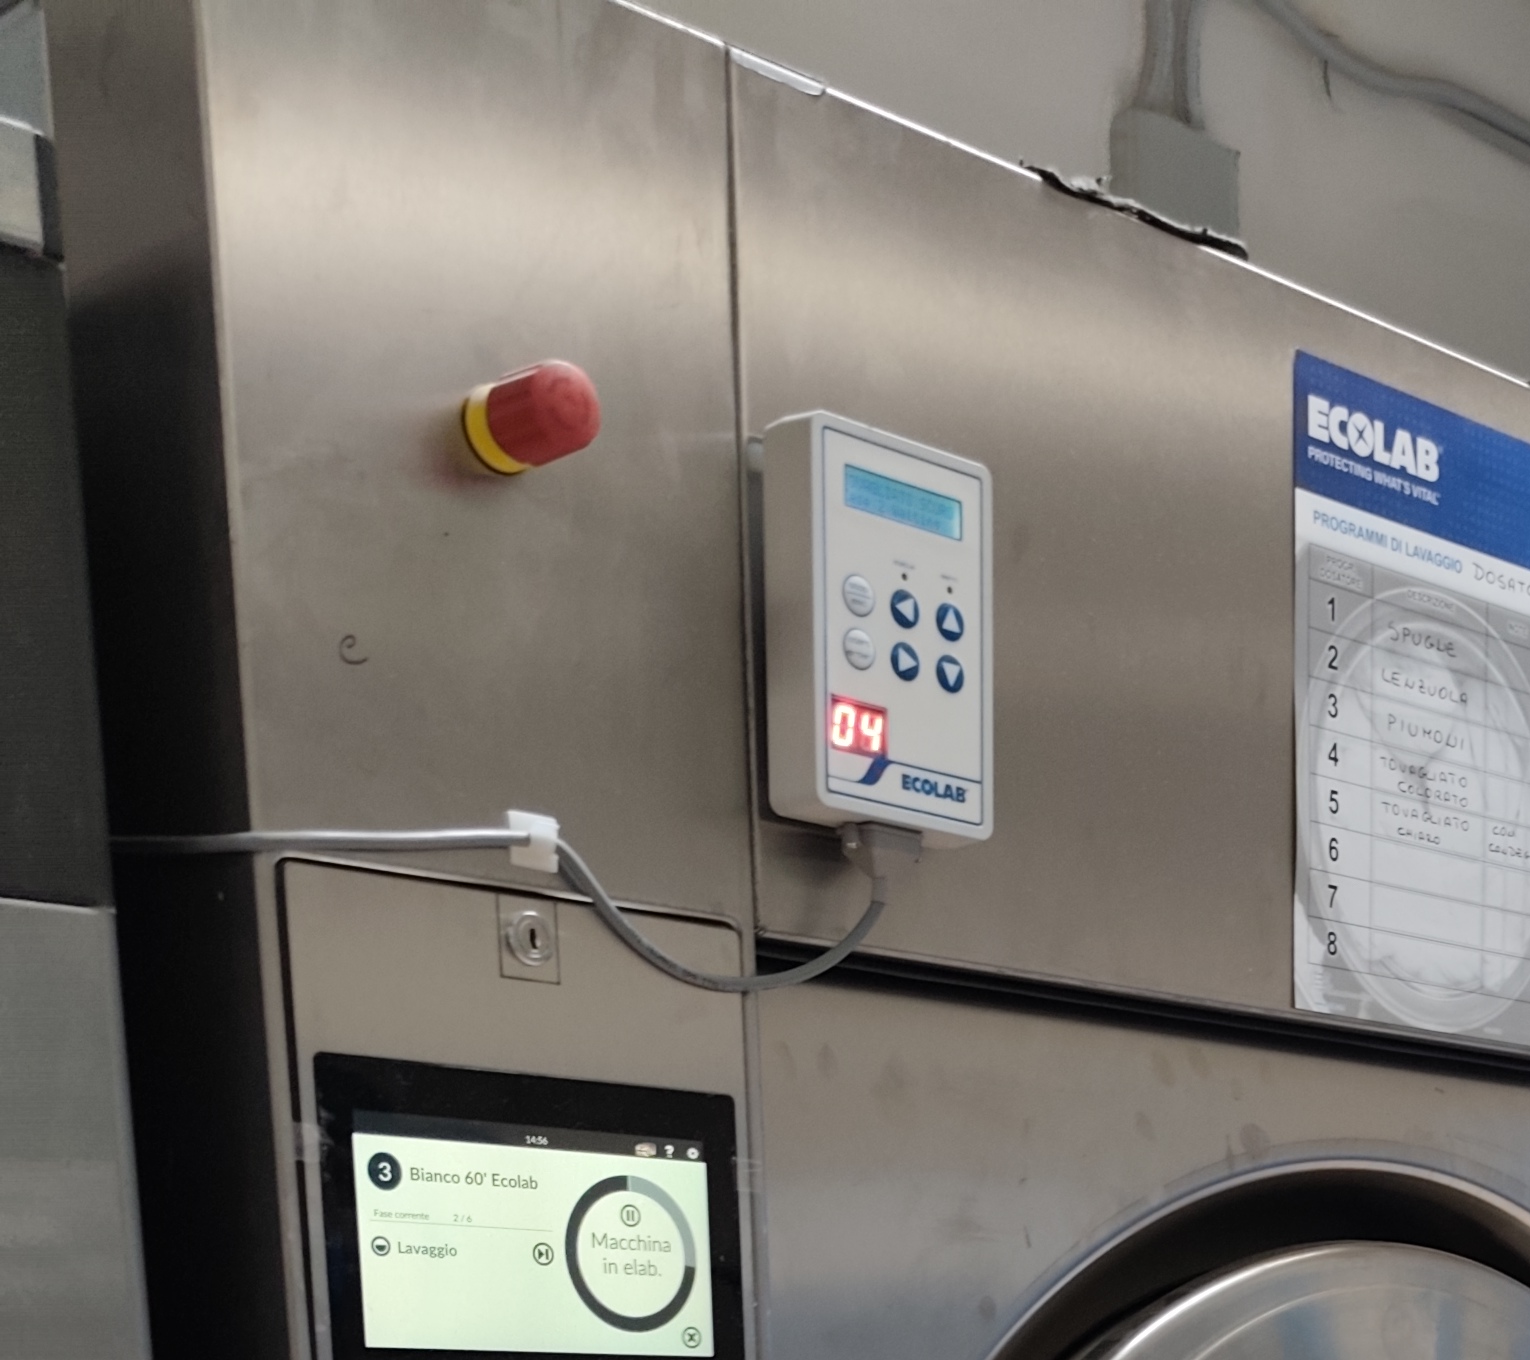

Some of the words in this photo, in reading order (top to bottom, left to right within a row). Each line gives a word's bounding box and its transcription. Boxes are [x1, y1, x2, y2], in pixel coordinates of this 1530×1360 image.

[1307, 394, 1440, 483] ECOLAB
[1307, 445, 1373, 482] PROTECTING
[1313, 510, 1388, 549] PROGRAMMI
[1391, 537, 1402, 554] DI
[1405, 541, 1463, 574] LAVAGGIO
[1327, 597, 1336, 622] 1
[1327, 645, 1339, 670] 2
[1327, 693, 1339, 718] 3
[831, 704, 883, 752] 04
[1327, 742, 1339, 767] 4
[901, 774, 966, 803] ECOLAB
[1327, 790, 1339, 815] 5
[1328, 838, 1339, 862] 6
[1327, 884, 1338, 908] 7
[1326, 931, 1338, 956] 8
[377, 1161, 393, 1182] 3
[410, 1167, 460, 1184] Bianco
[464, 1171, 487, 1186] 60'
[491, 1173, 538, 1190] Ecolab
[373, 1209, 393, 1219] Fase
[394, 1211, 430, 1221] corrente
[398, 1241, 458, 1259] Lavaggio
[591, 1232, 672, 1253] Macchina
[603, 1257, 618, 1275] in
[624, 1258, 662, 1278] elab.
